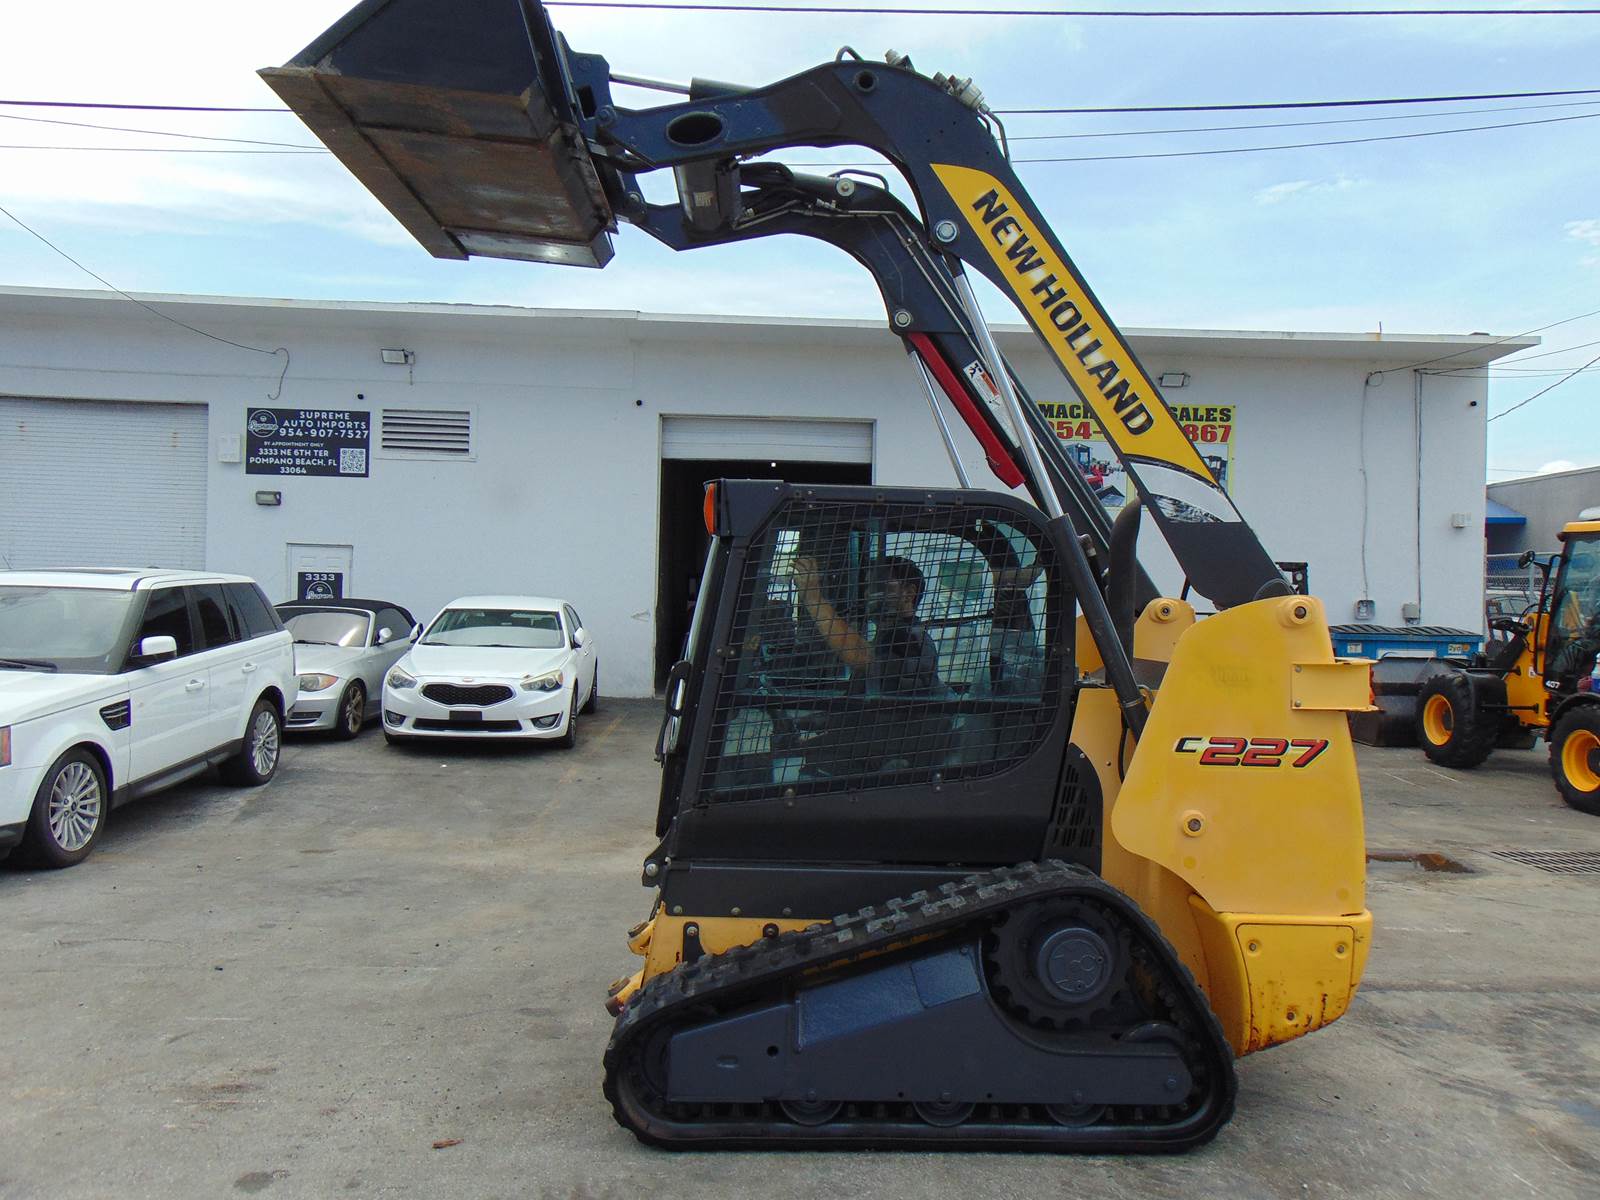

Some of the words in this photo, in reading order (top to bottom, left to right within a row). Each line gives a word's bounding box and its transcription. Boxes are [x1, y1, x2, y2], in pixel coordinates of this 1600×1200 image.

[972, 188, 1046, 276] NEW
[1030, 273, 1155, 436] HOLLAND
[300, 411, 350, 420] SUPREME
[283, 420, 313, 428] AUTO
[317, 420, 366, 429] IMPORTS
[279, 428, 369, 439] 954-907-7527
[313, 449, 329, 457] TER
[249, 457, 293, 465] POMPANO
[305, 573, 335, 581] 3333
